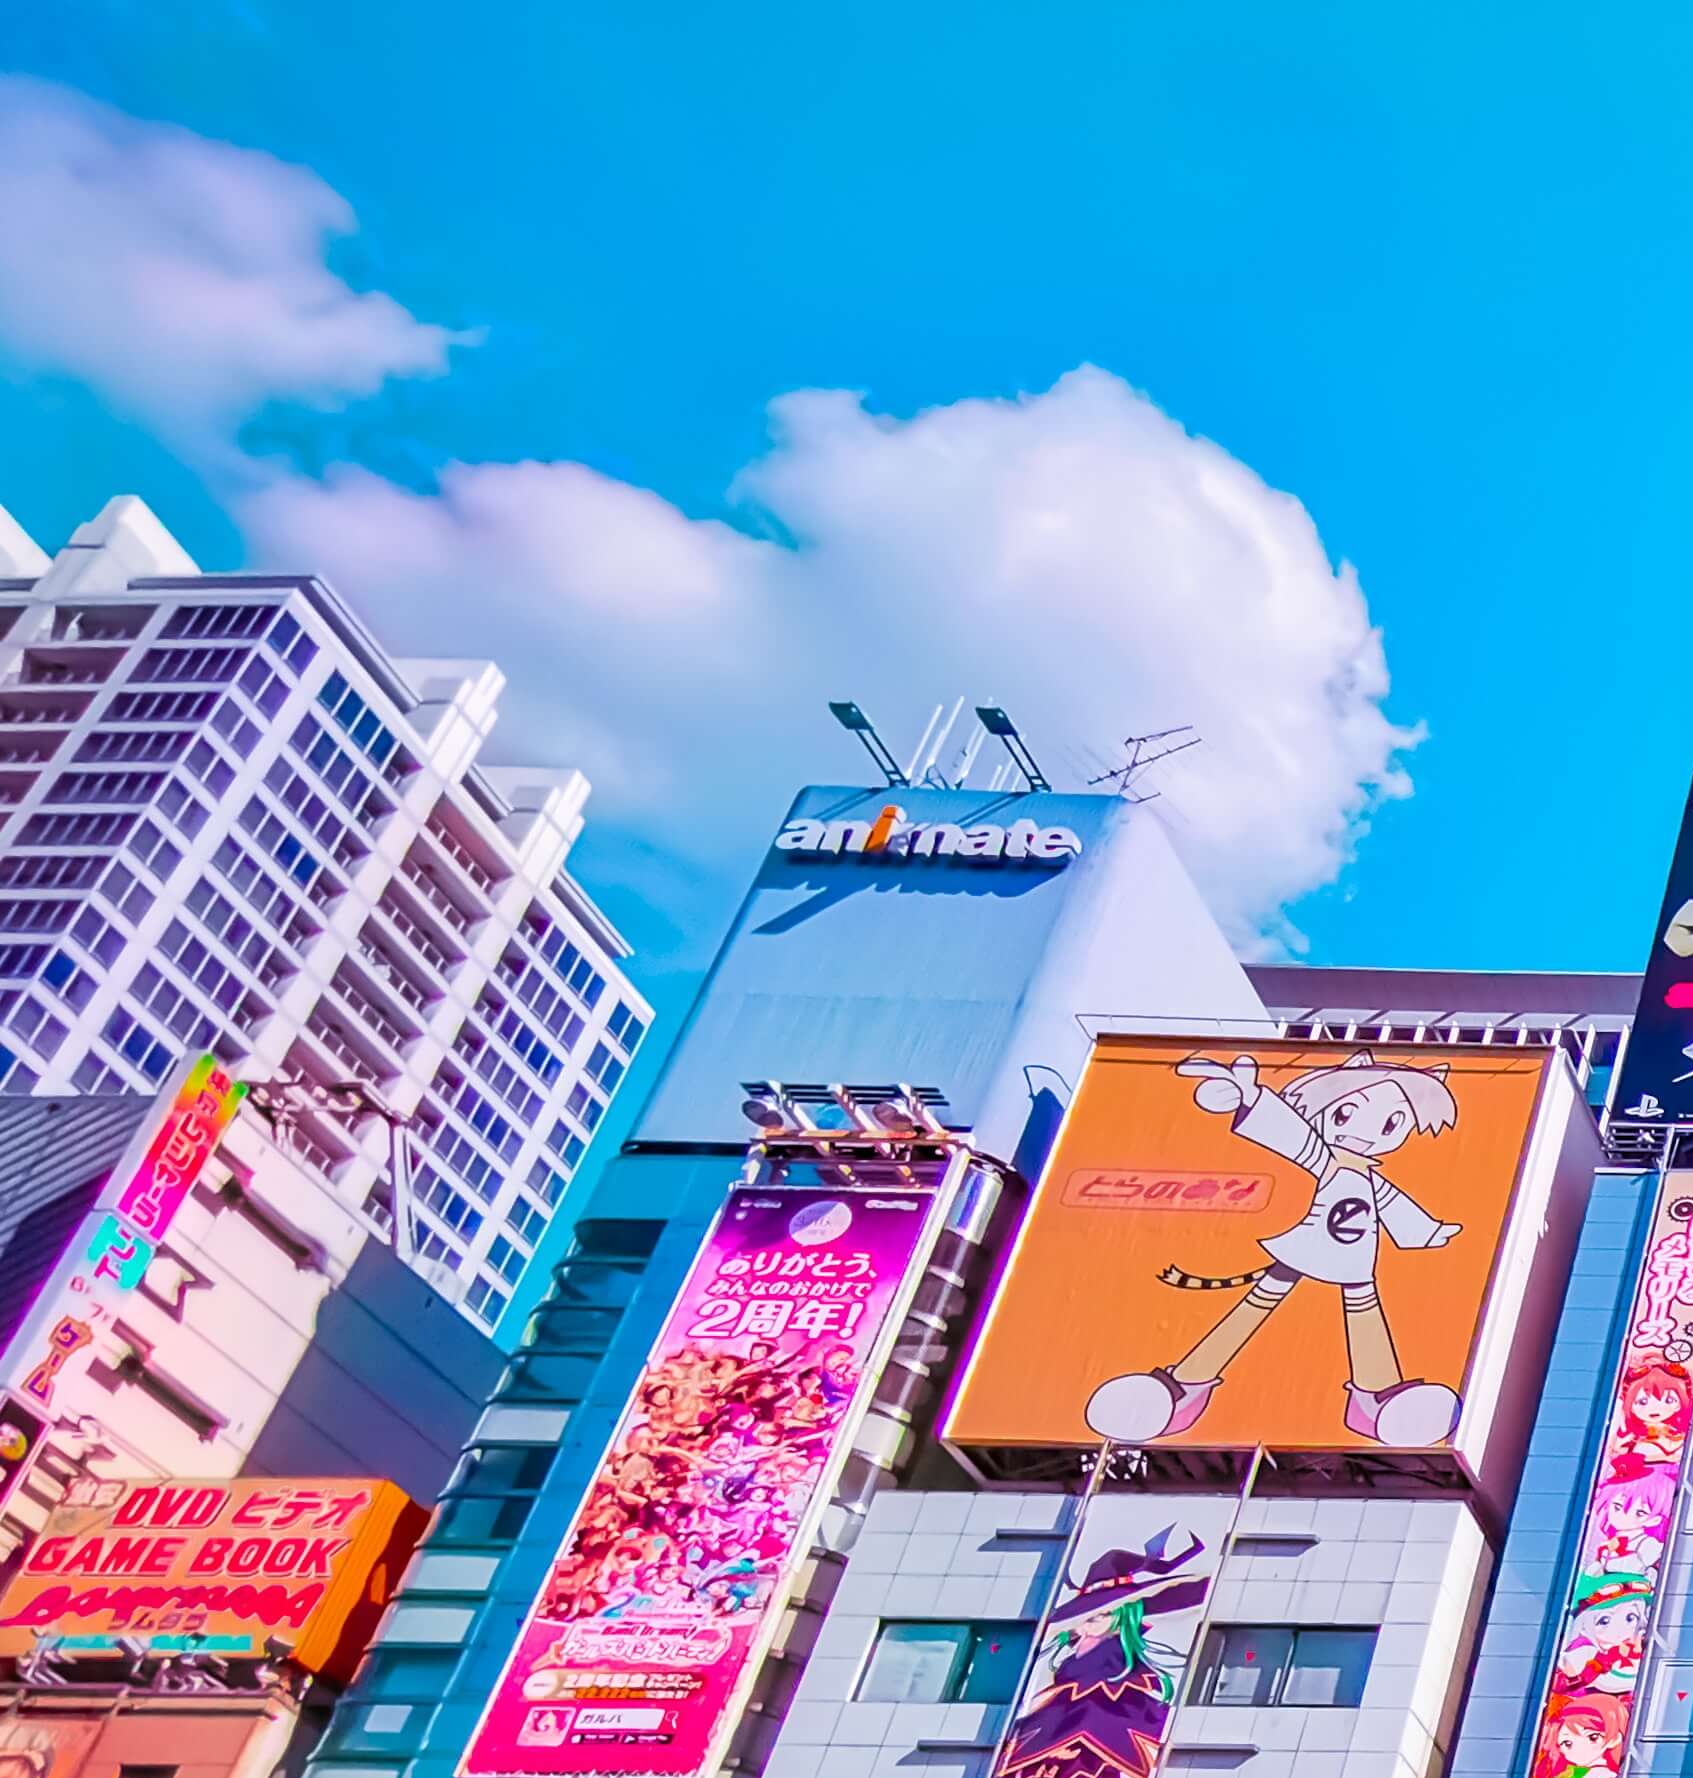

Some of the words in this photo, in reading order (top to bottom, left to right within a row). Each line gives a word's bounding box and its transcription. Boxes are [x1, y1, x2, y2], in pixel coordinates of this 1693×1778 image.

[775, 806, 1083, 859] animate
[112, 1486, 231, 1529] DVD
[232, 1487, 372, 1531] ビデオ
[25, 1537, 189, 1576] GAME
[190, 1537, 353, 1578] BOOK
